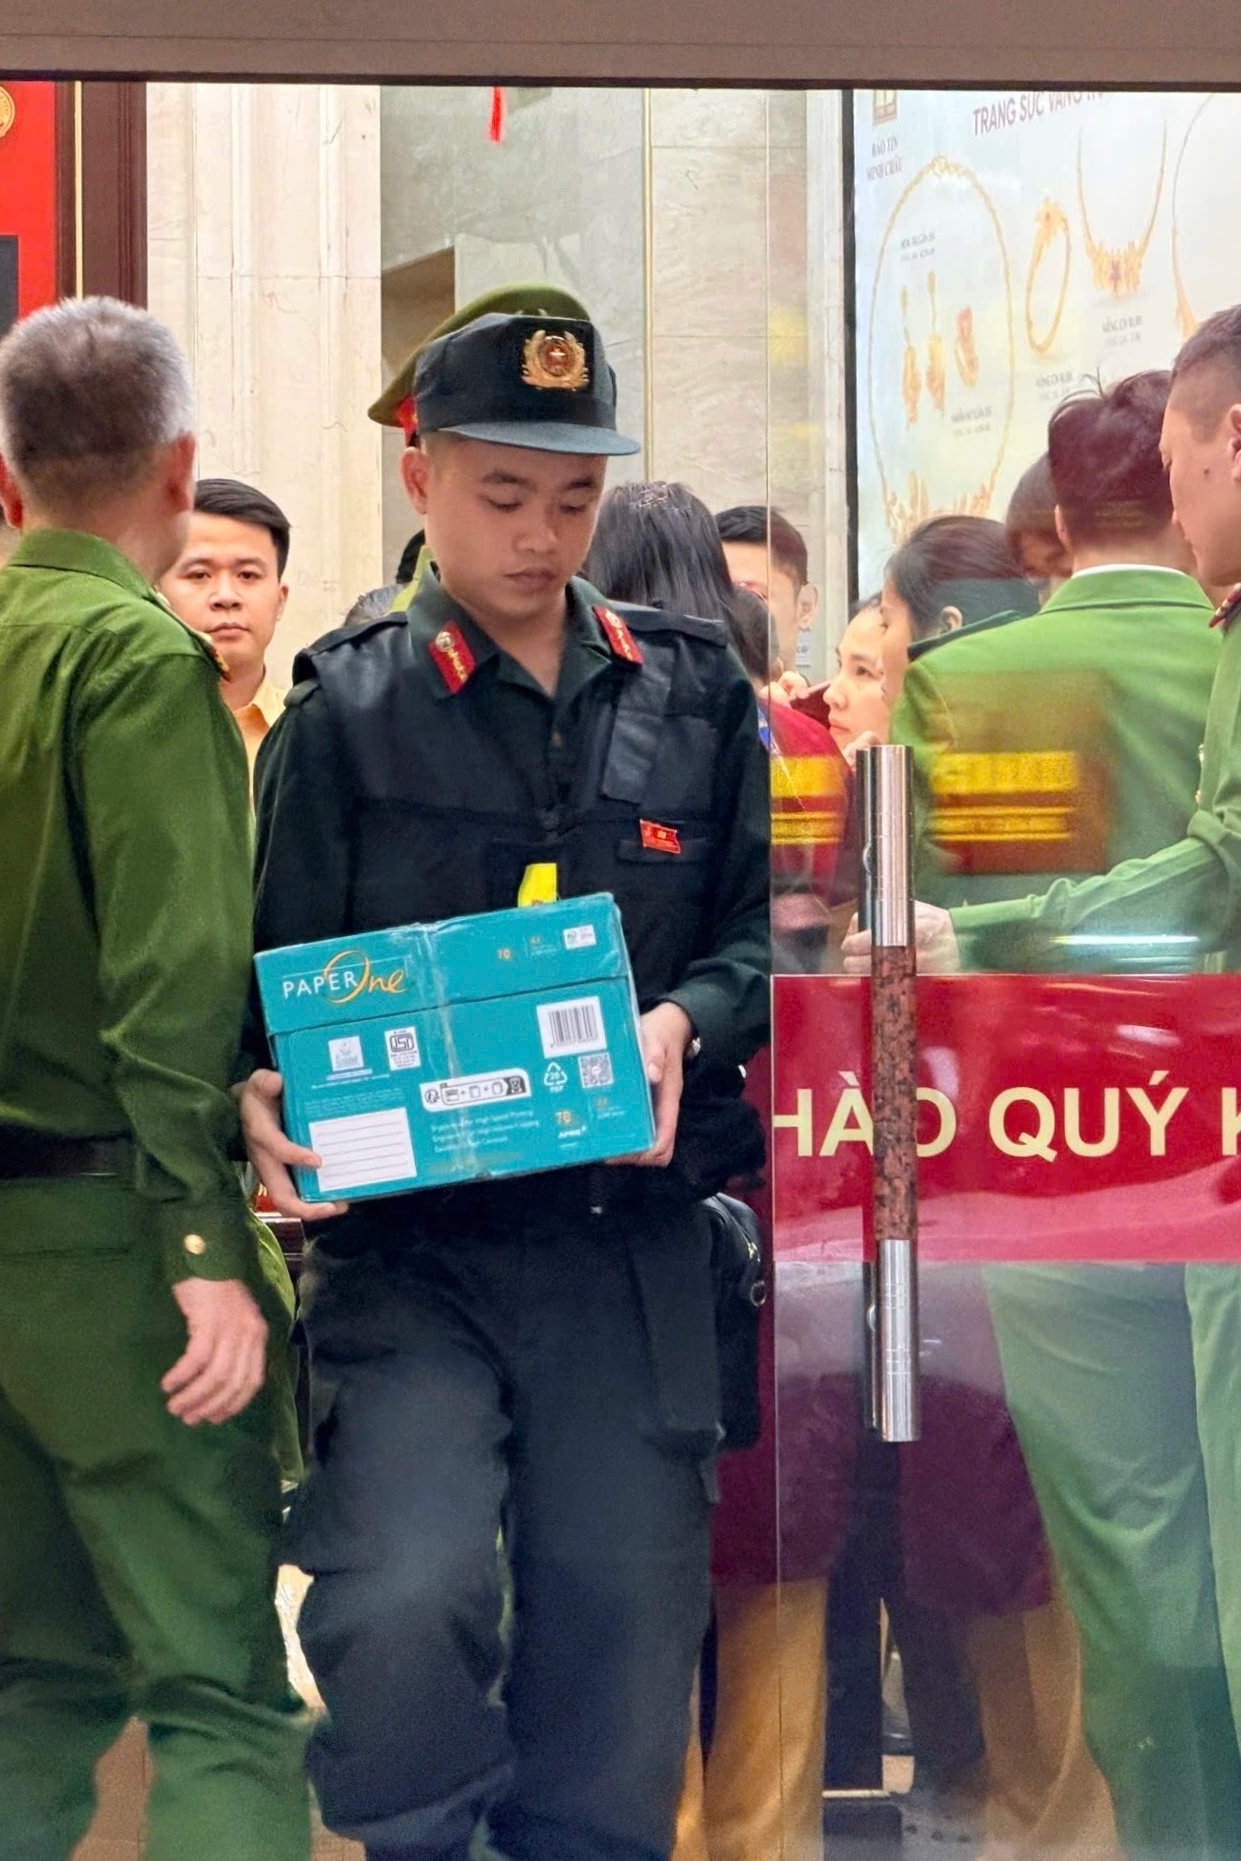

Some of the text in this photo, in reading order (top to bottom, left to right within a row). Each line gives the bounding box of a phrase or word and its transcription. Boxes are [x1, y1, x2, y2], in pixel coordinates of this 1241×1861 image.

[972, 98, 1017, 136] TRANG
[773, 1071, 958, 1158] HÀO
[988, 1069, 1190, 1164] QUÝ
